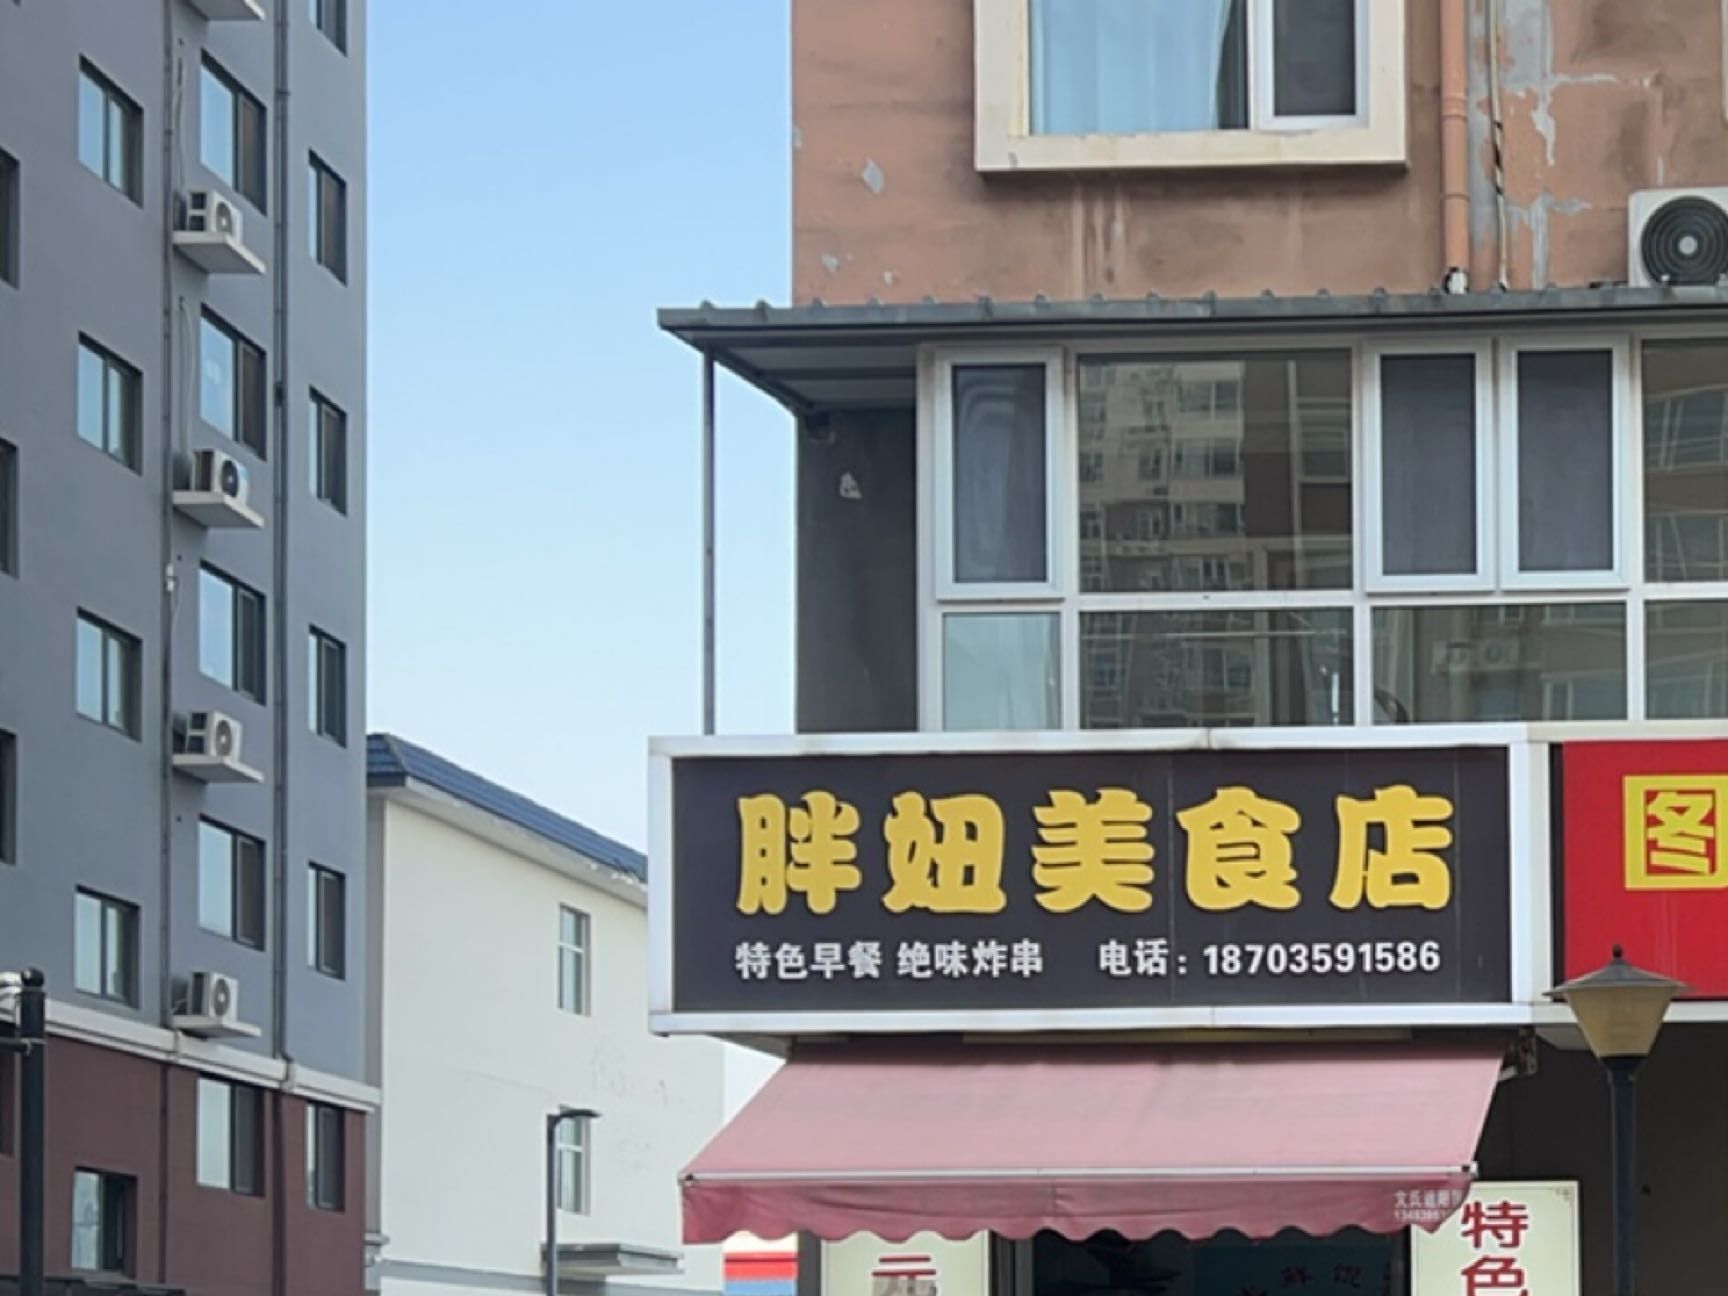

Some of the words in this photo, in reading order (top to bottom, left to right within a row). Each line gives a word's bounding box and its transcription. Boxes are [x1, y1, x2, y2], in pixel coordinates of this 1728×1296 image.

[736, 784, 1455, 915] 胖妞美食店
[734, 940, 882, 980] 特色早餐
[896, 938, 1045, 978] 绝味炸串
